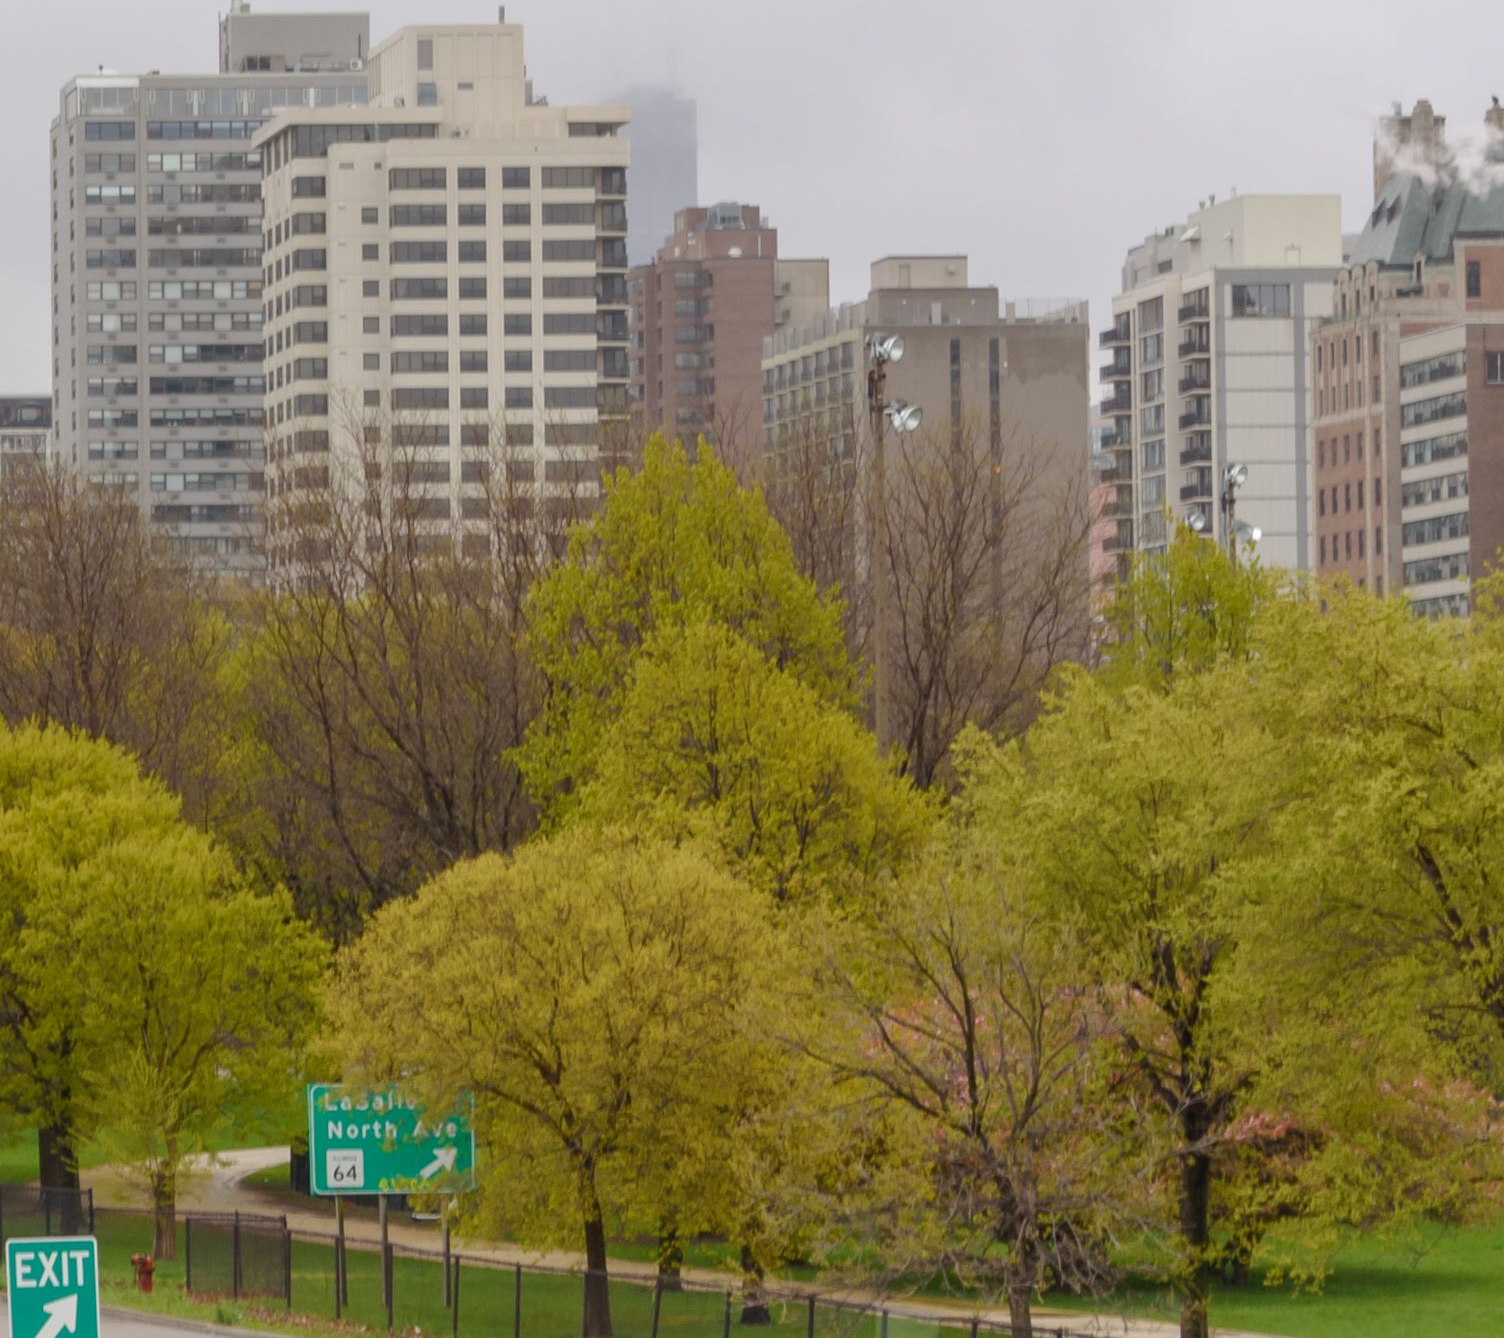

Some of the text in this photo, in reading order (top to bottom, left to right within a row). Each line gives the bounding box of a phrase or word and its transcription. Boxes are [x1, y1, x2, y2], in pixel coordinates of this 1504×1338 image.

[327, 1120, 457, 1139] North Ave
[333, 1165, 357, 1181] 64
[15, 1250, 90, 1288] EXIT
